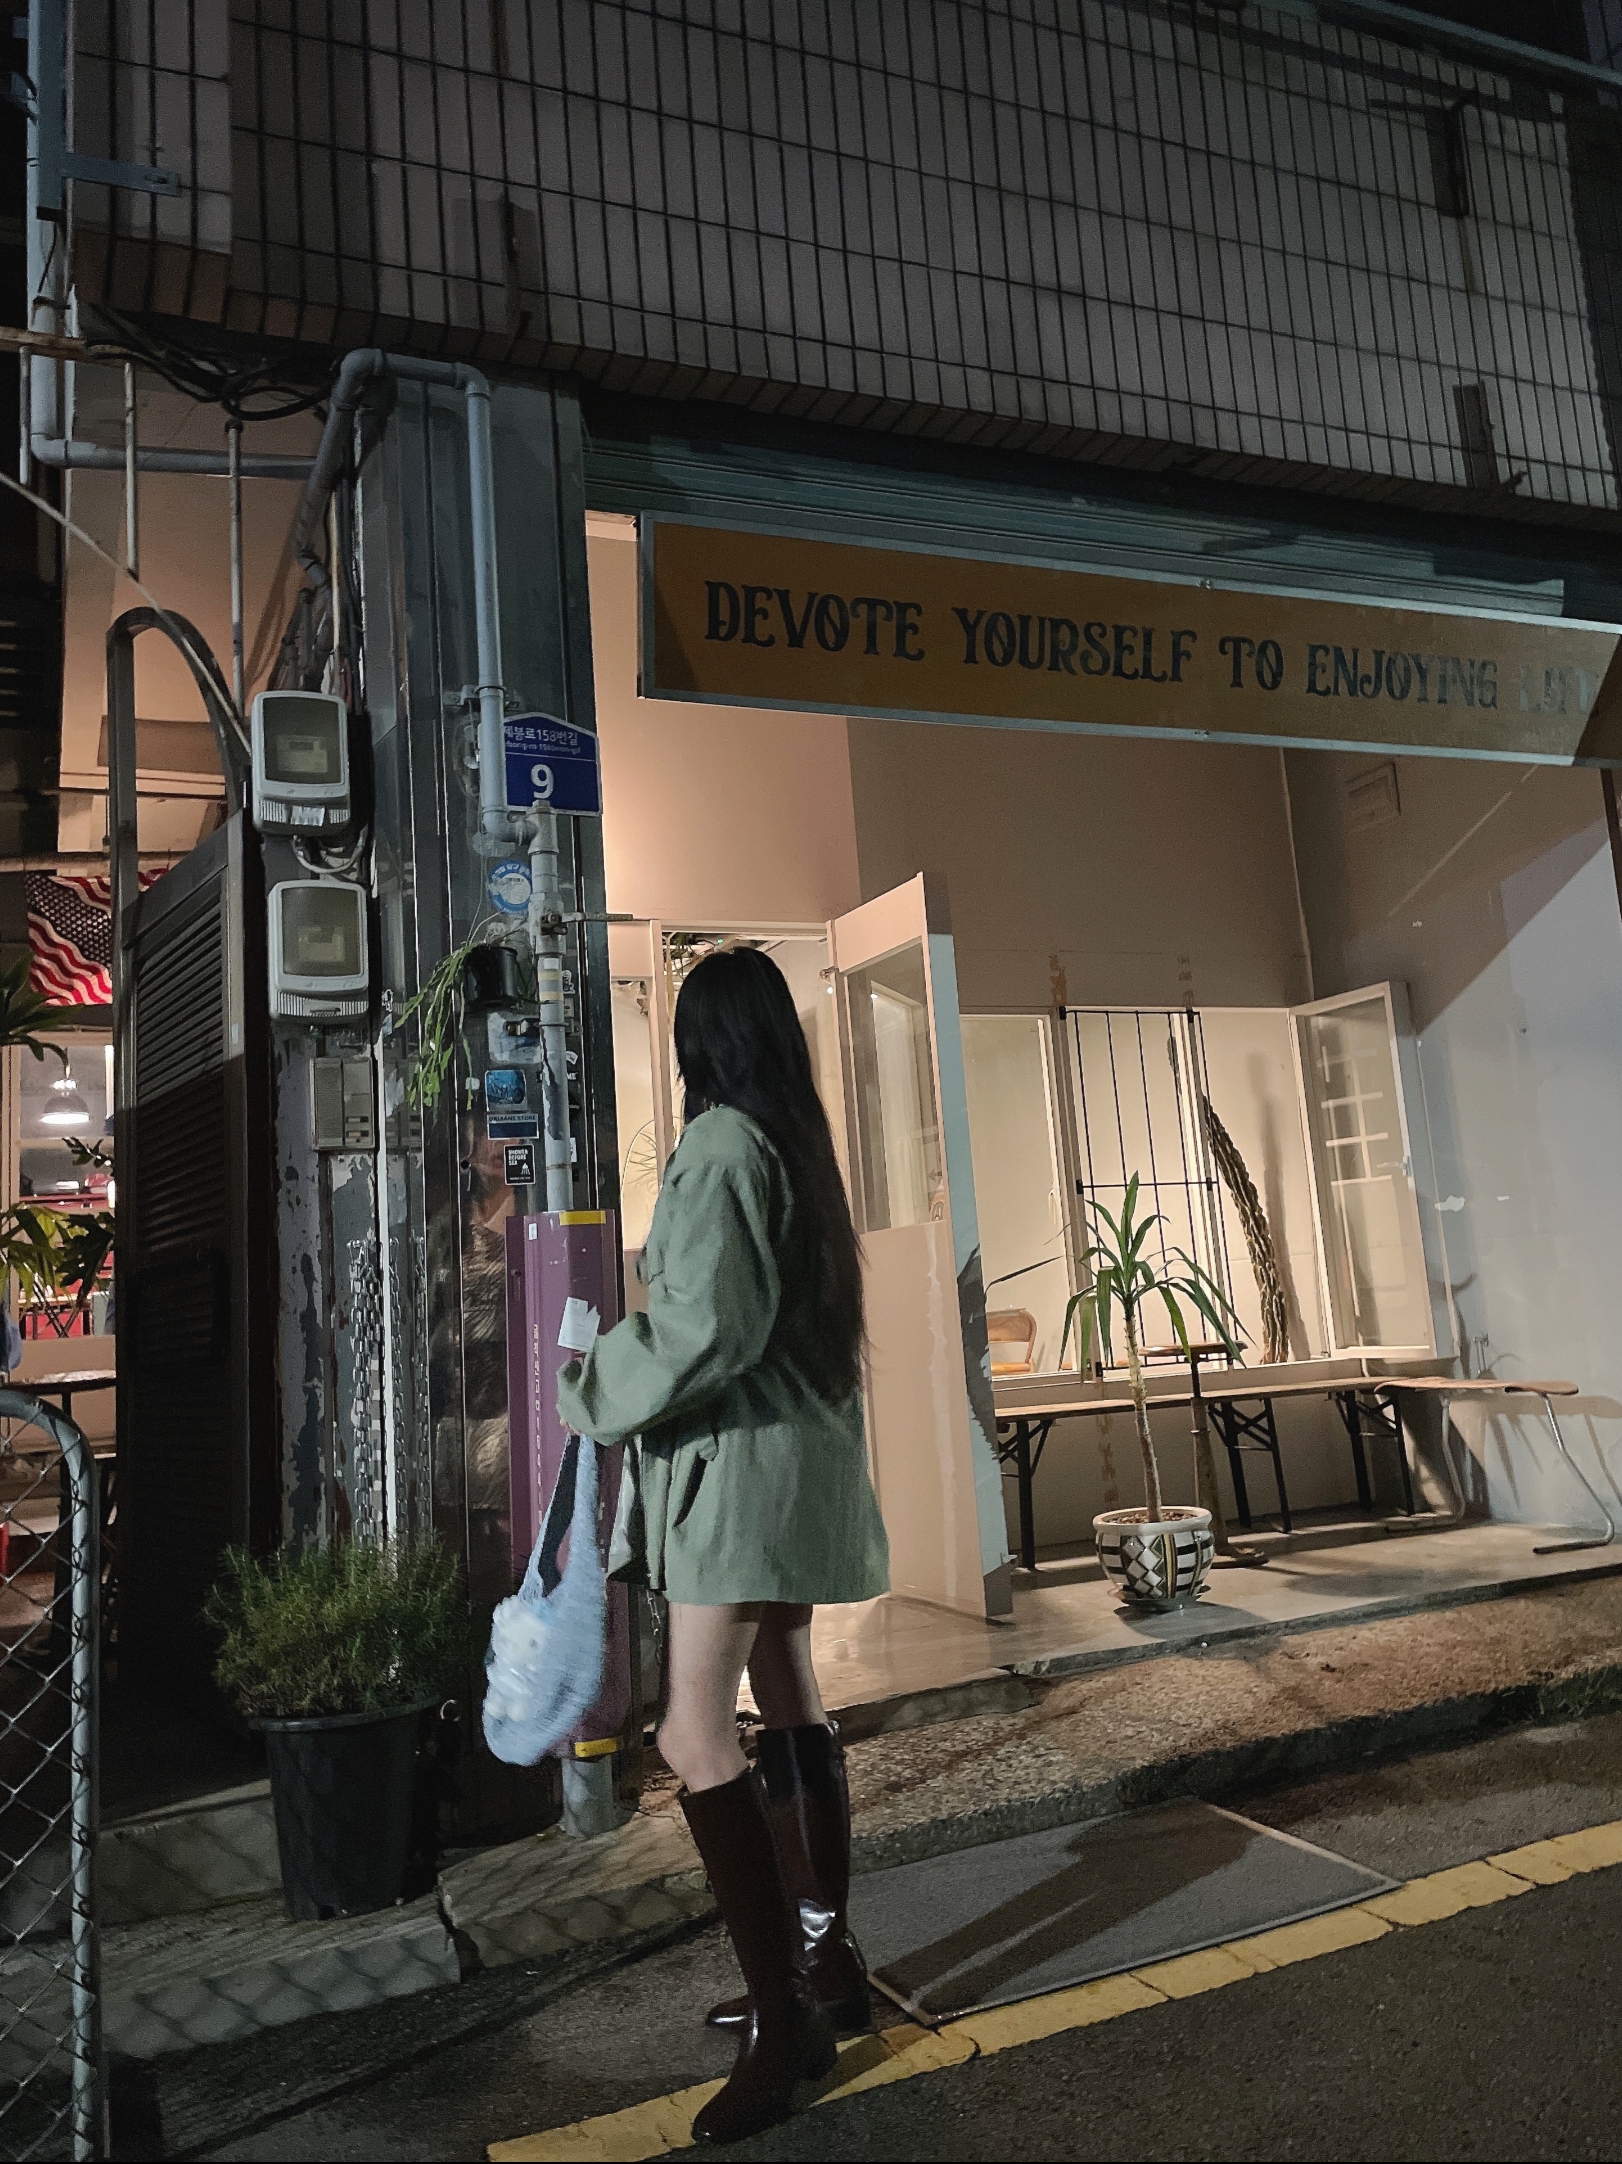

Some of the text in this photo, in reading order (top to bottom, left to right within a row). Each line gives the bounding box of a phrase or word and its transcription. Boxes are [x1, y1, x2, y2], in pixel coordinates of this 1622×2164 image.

[705, 579, 926, 662] DEVOTE
[951, 606, 1197, 684] YOURSELF
[1218, 635, 1285, 692] TO
[1305, 642, 1498, 710] ENJOYING
[530, 763, 555, 800] 9
